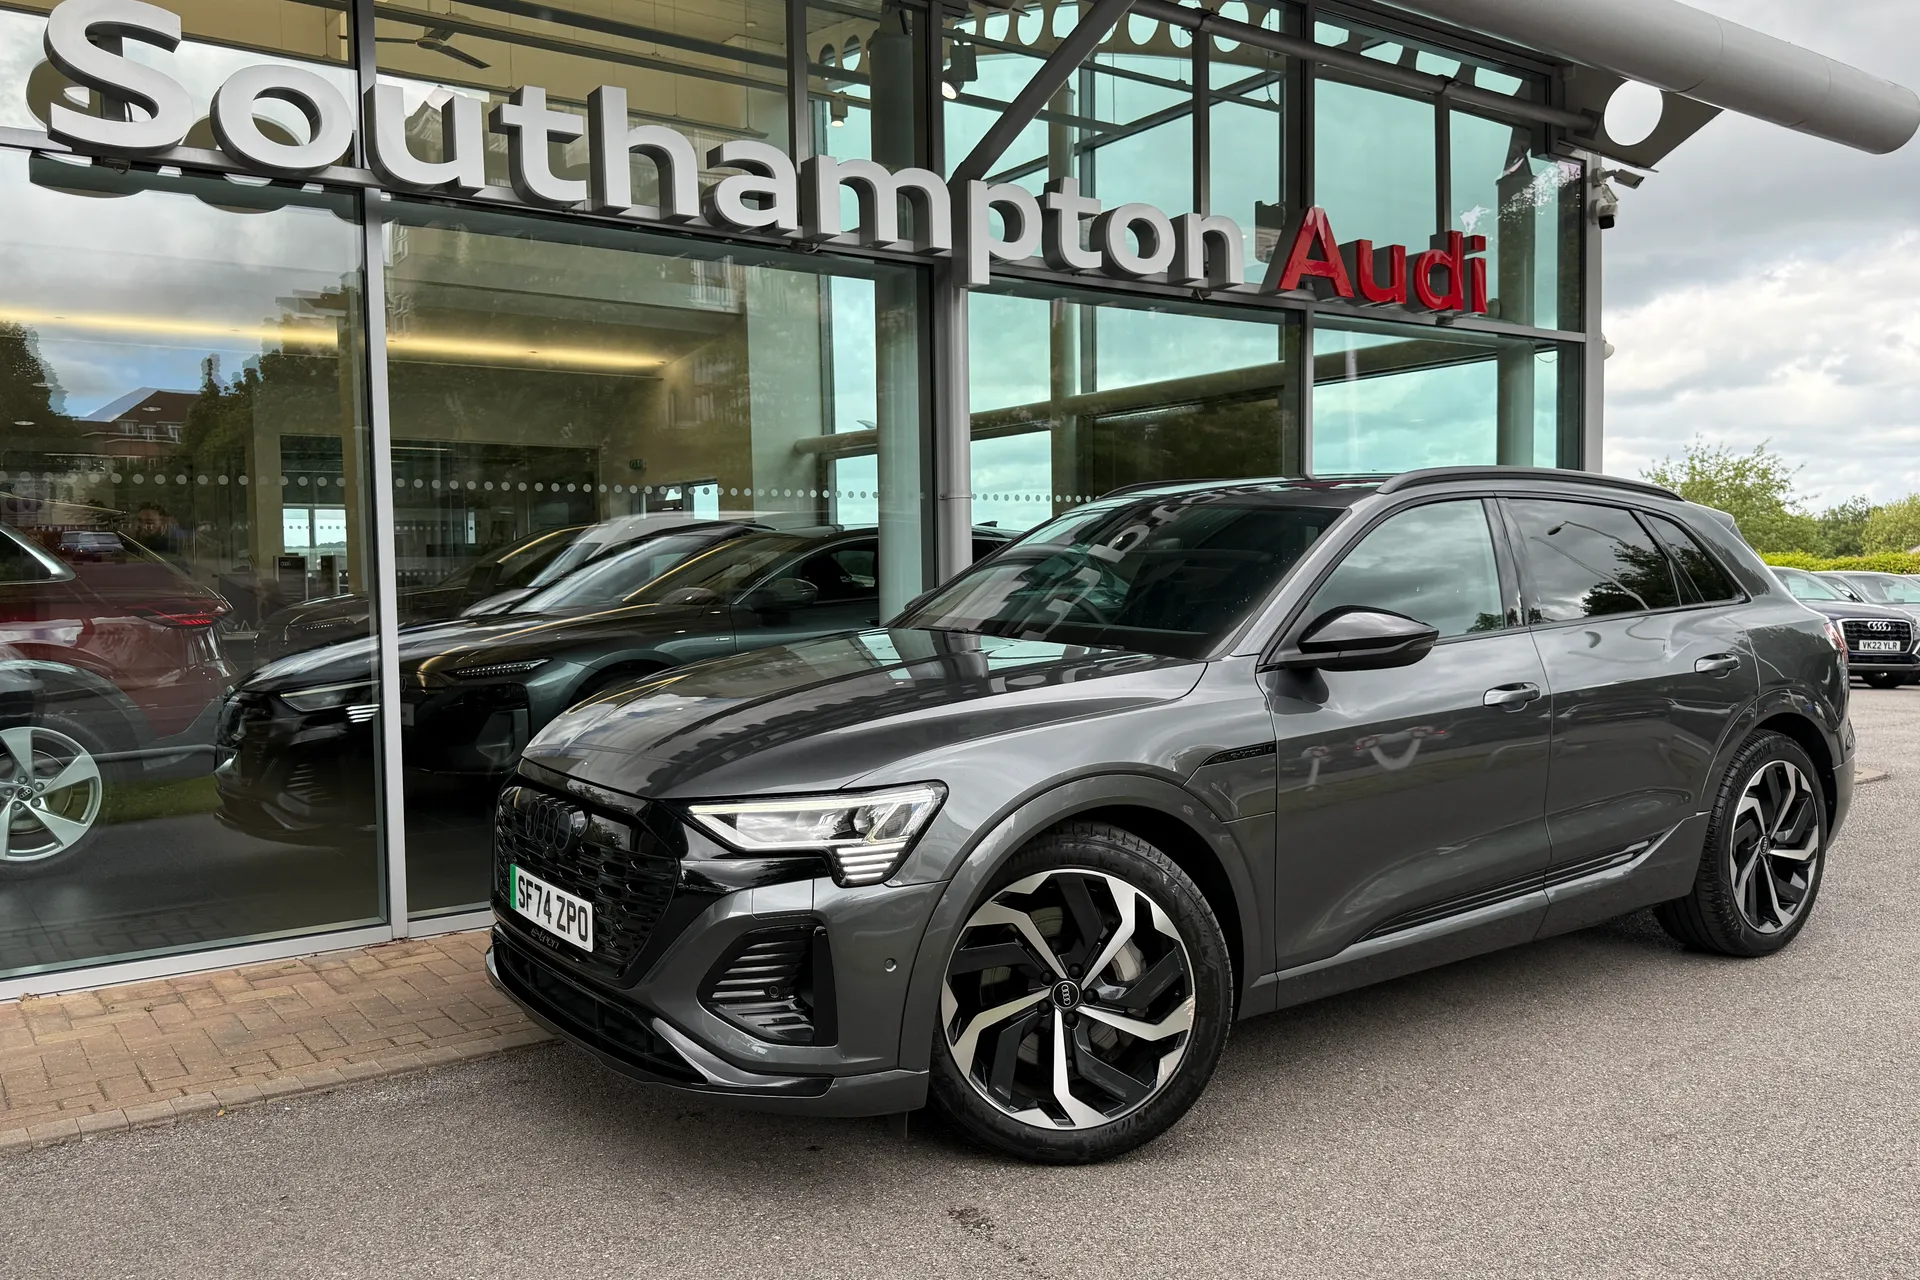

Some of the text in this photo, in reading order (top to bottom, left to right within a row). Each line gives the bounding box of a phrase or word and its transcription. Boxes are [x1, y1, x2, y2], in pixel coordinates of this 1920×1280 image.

[44, 0, 1488, 314] Southampton Audi
[1862, 642, 1898, 650] VK22 YLR
[518, 875, 588, 942] SF74 ZPO
[530, 927, 560, 951] e-tron
